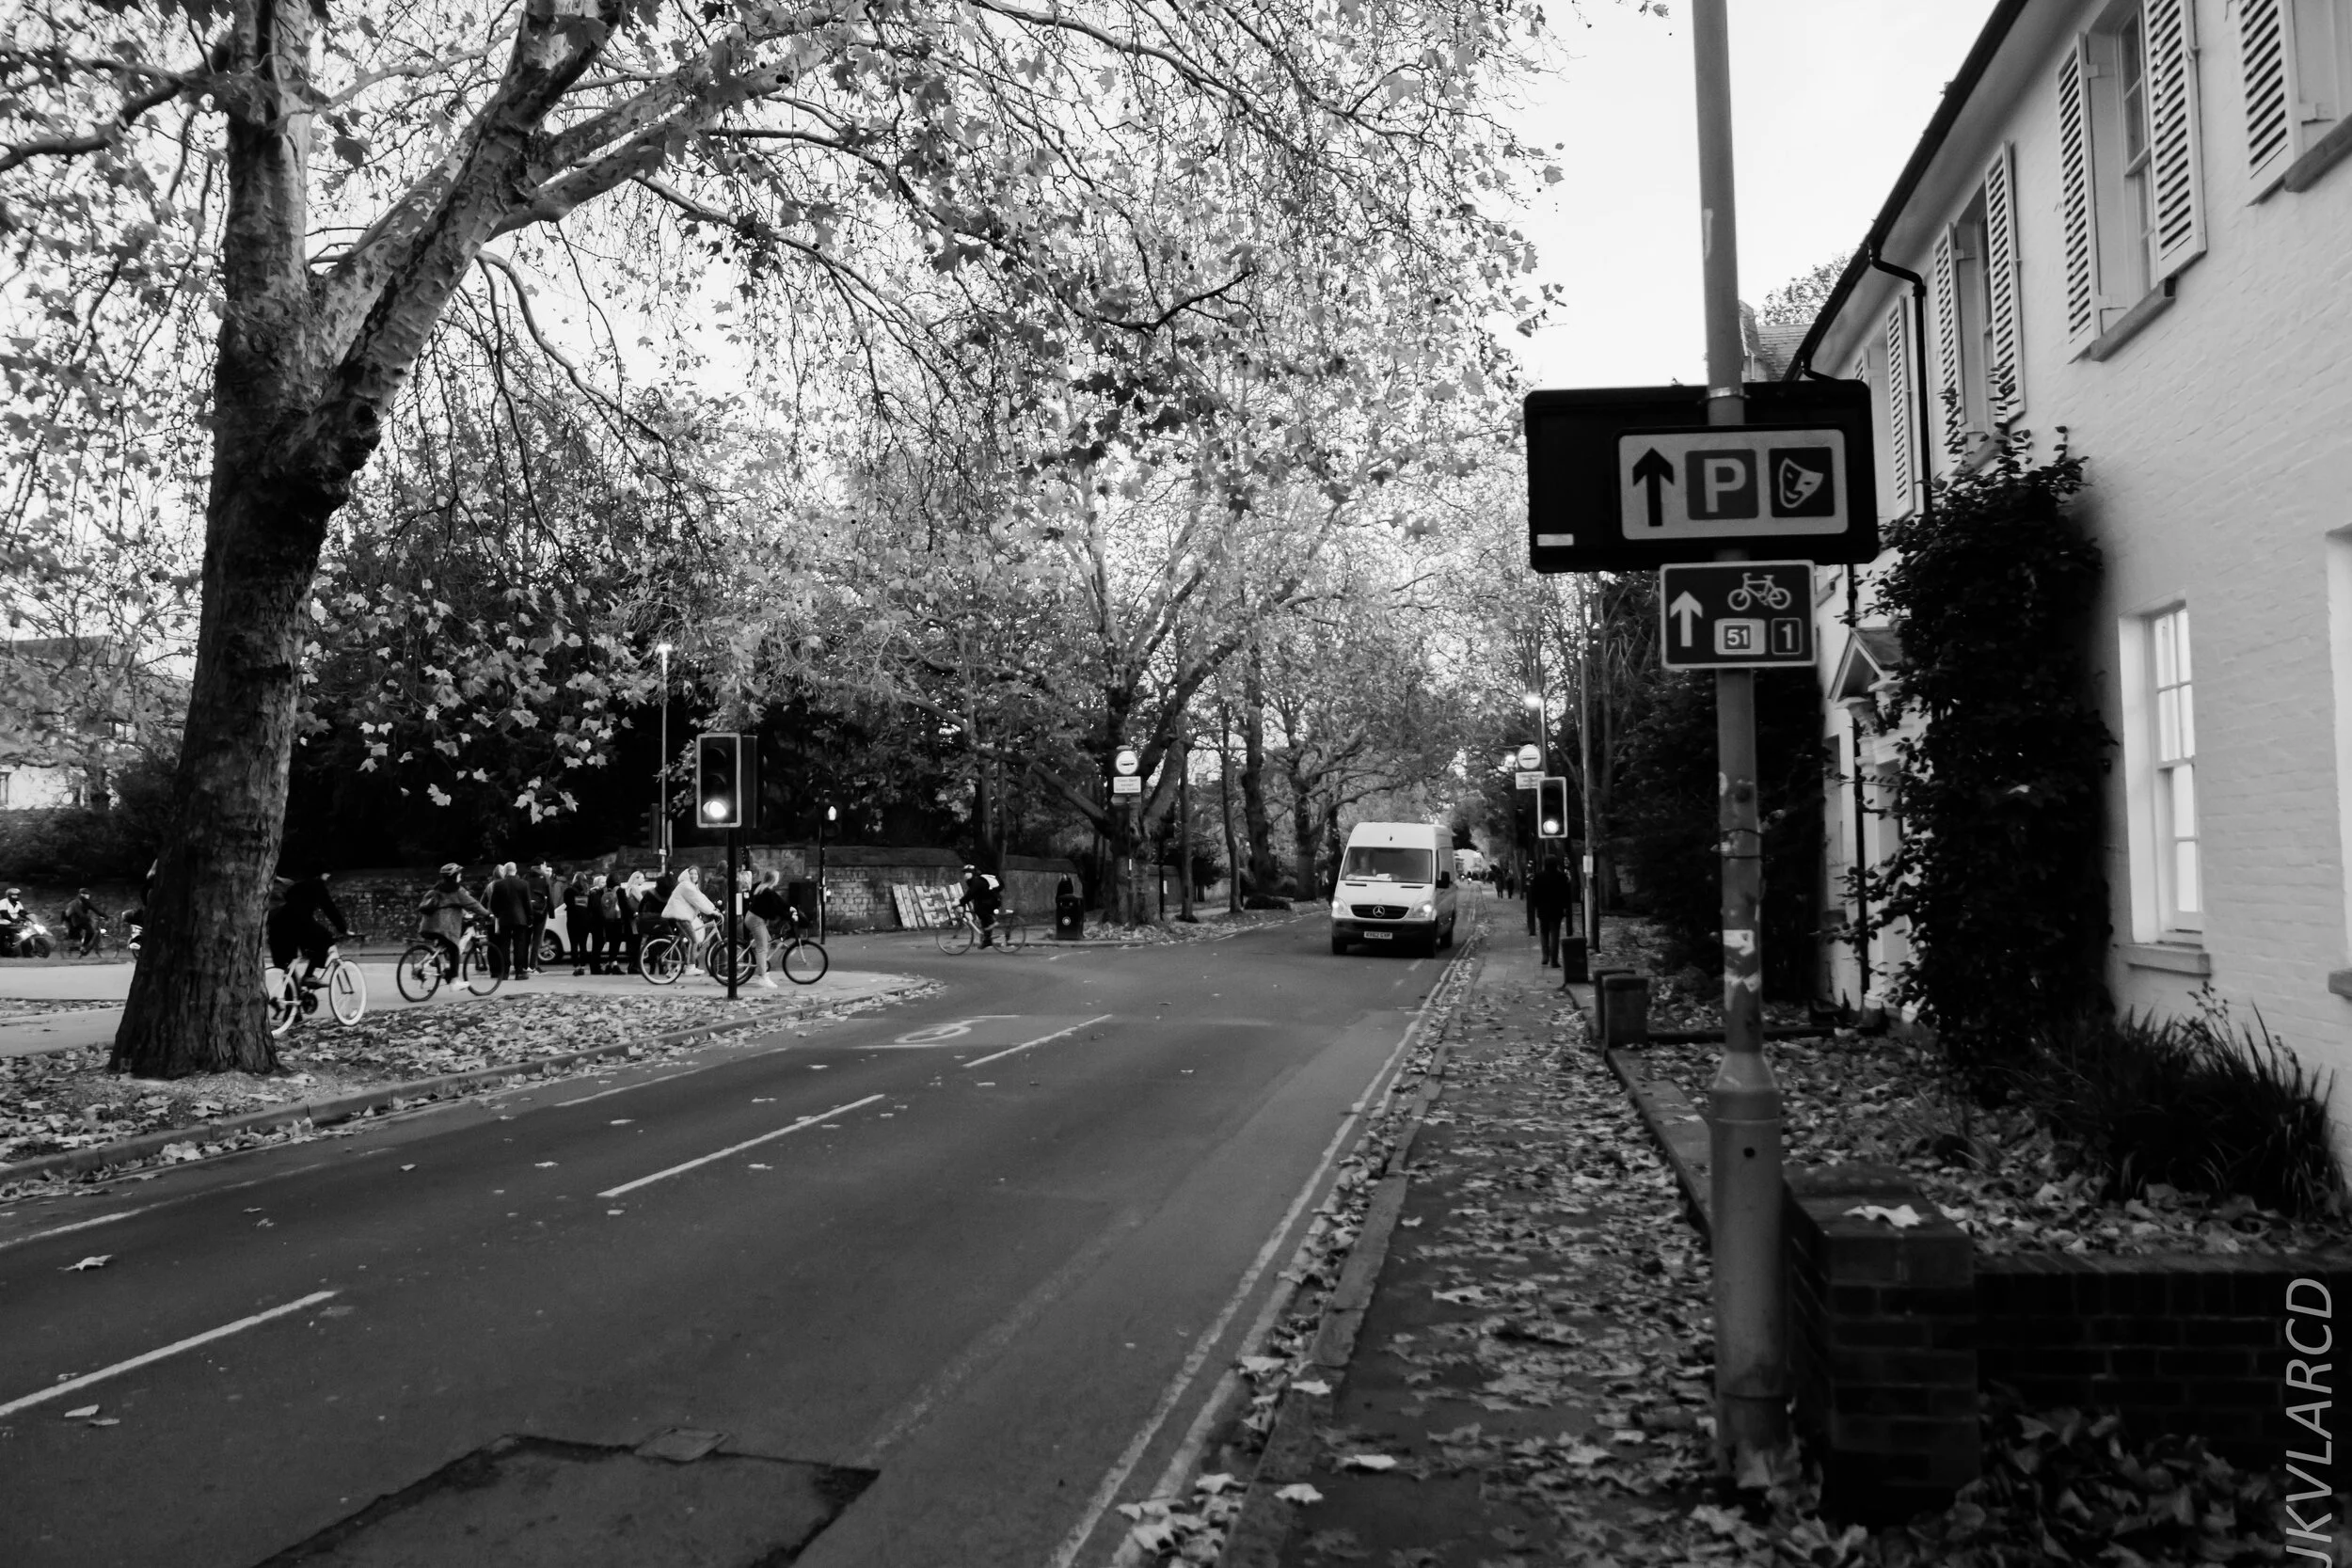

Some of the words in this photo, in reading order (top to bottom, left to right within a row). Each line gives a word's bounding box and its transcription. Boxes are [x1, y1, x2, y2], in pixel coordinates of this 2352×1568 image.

[1703, 457, 1747, 513] P
[1727, 628, 1749, 646] 51
[1781, 623, 1792, 649] 1
